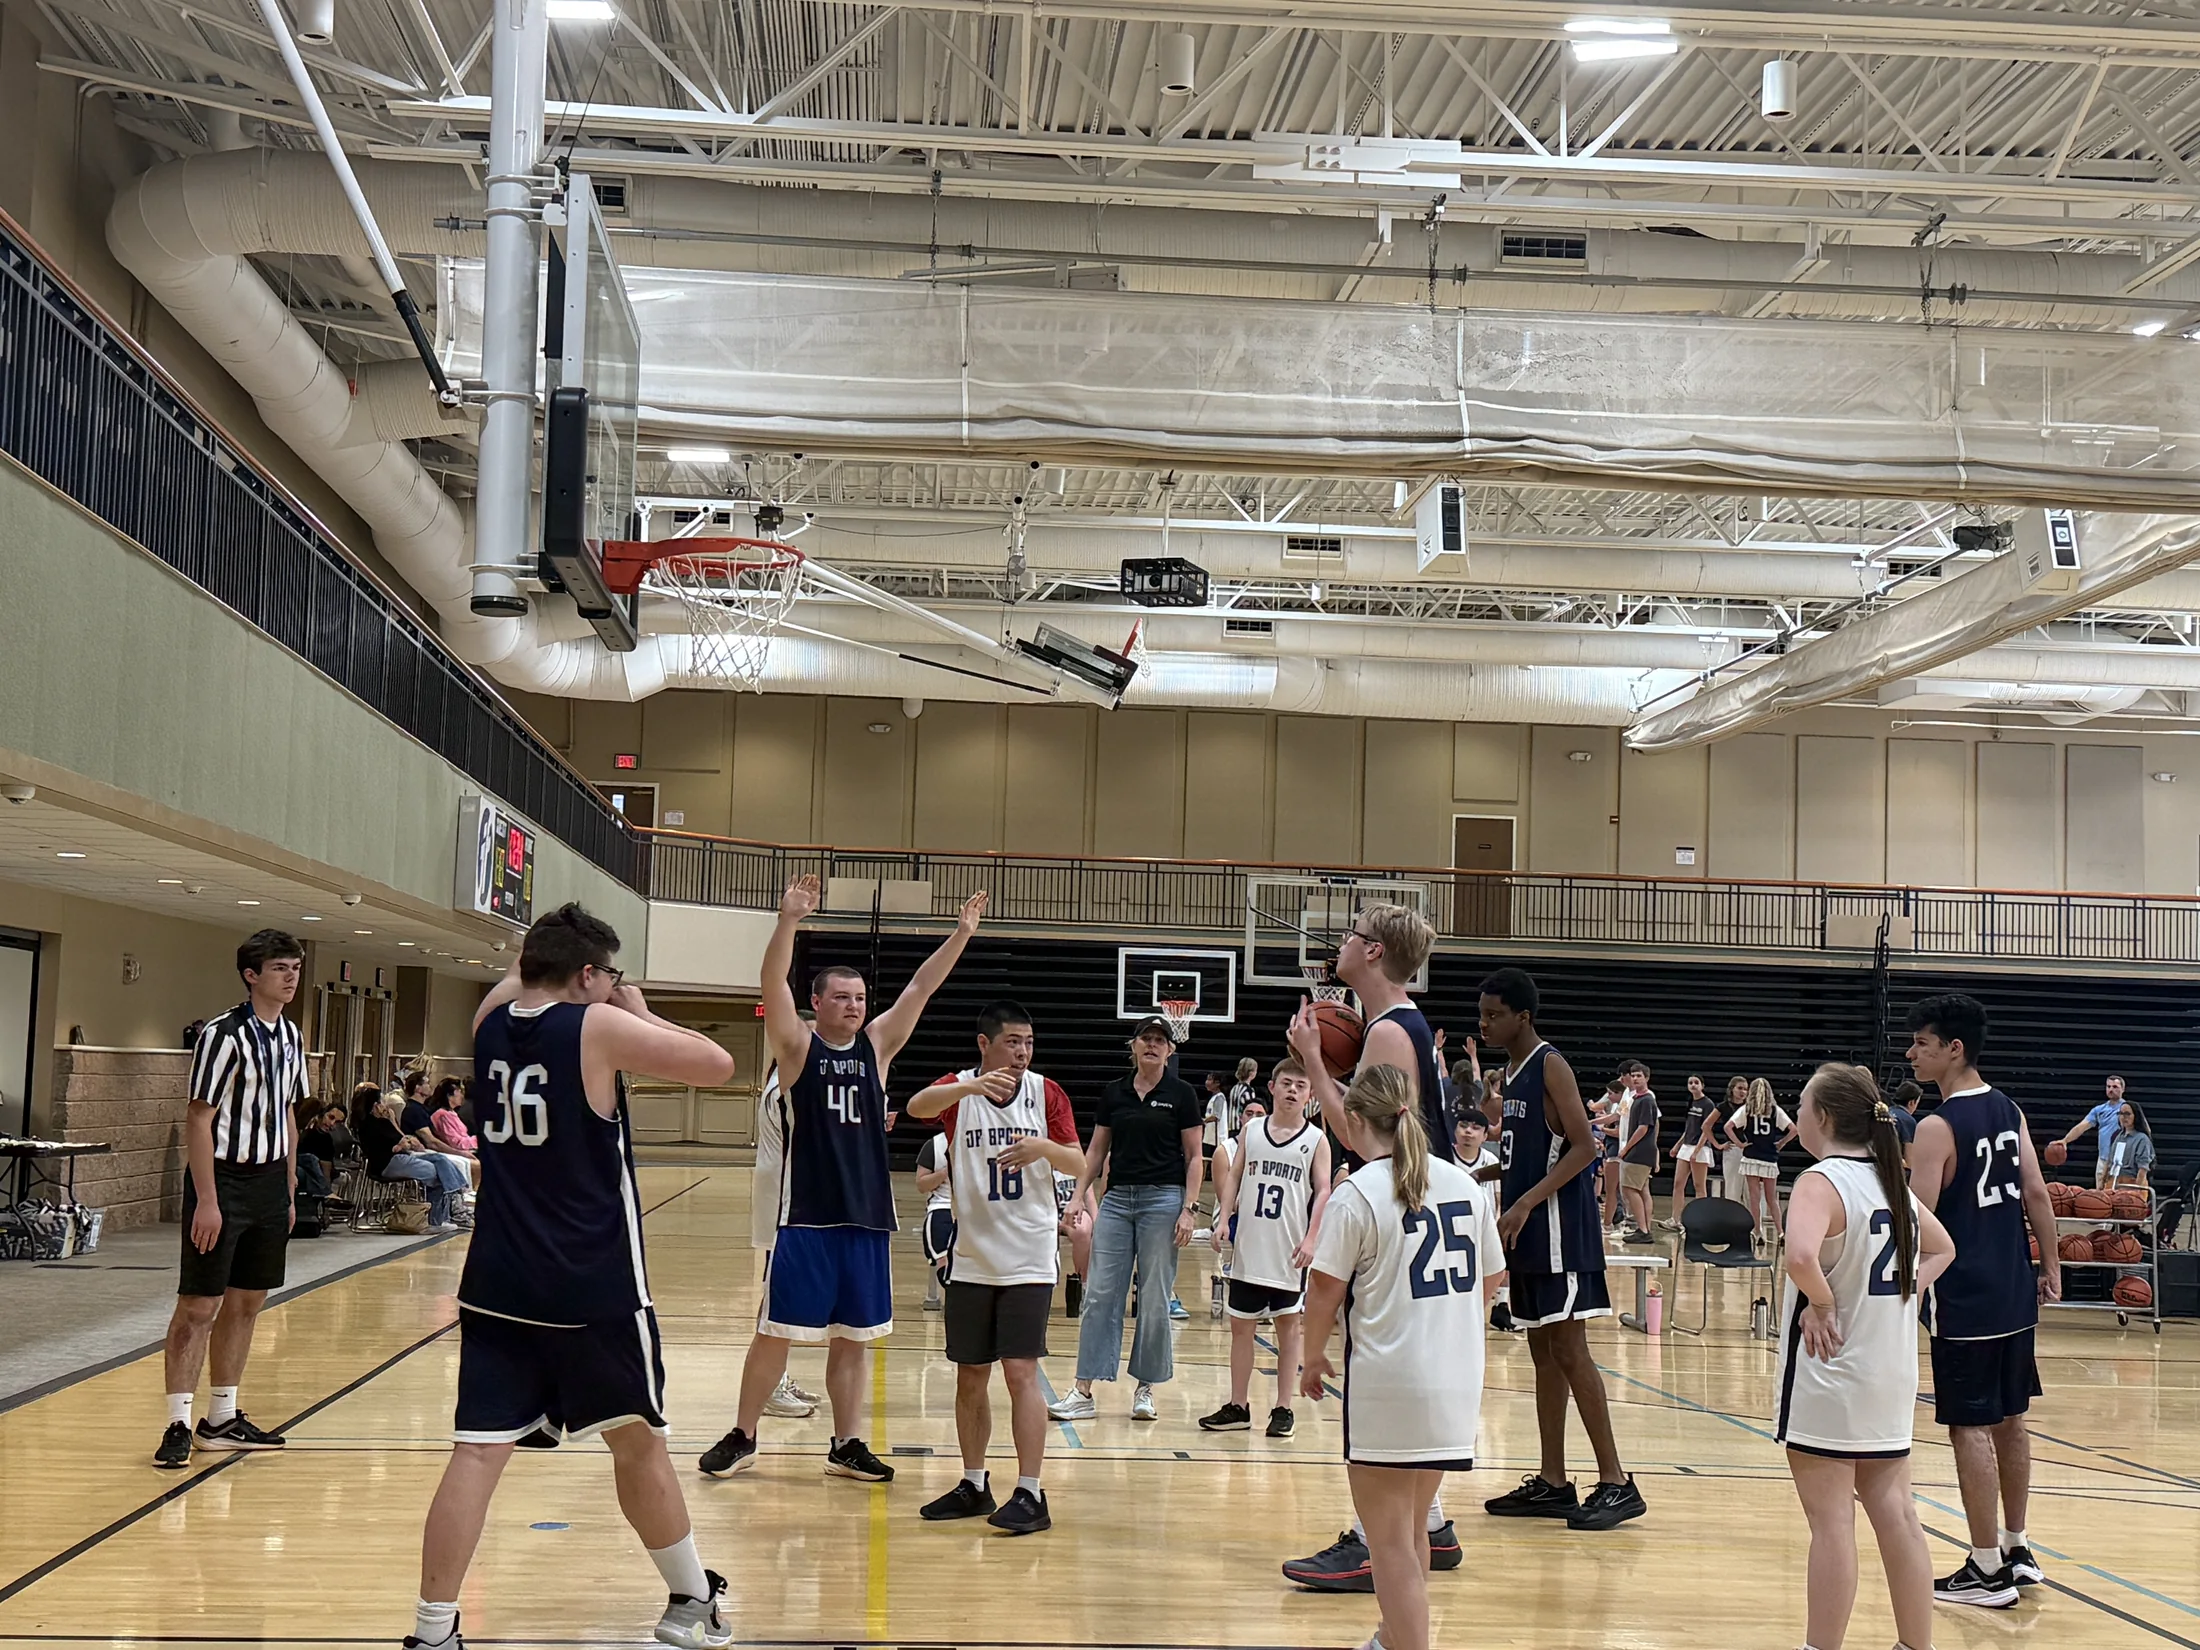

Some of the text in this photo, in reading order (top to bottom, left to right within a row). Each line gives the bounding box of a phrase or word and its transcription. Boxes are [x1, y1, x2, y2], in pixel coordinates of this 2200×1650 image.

[483, 1059, 549, 1147] 36
[827, 1084, 862, 1124] 40
[1753, 1114, 1771, 1135] 15
[1262, 1160, 1303, 1183] SPORTS
[1976, 1130, 2021, 1208] 23
[1254, 1182, 1285, 1220] 13
[1401, 1199, 1477, 1300] 25
